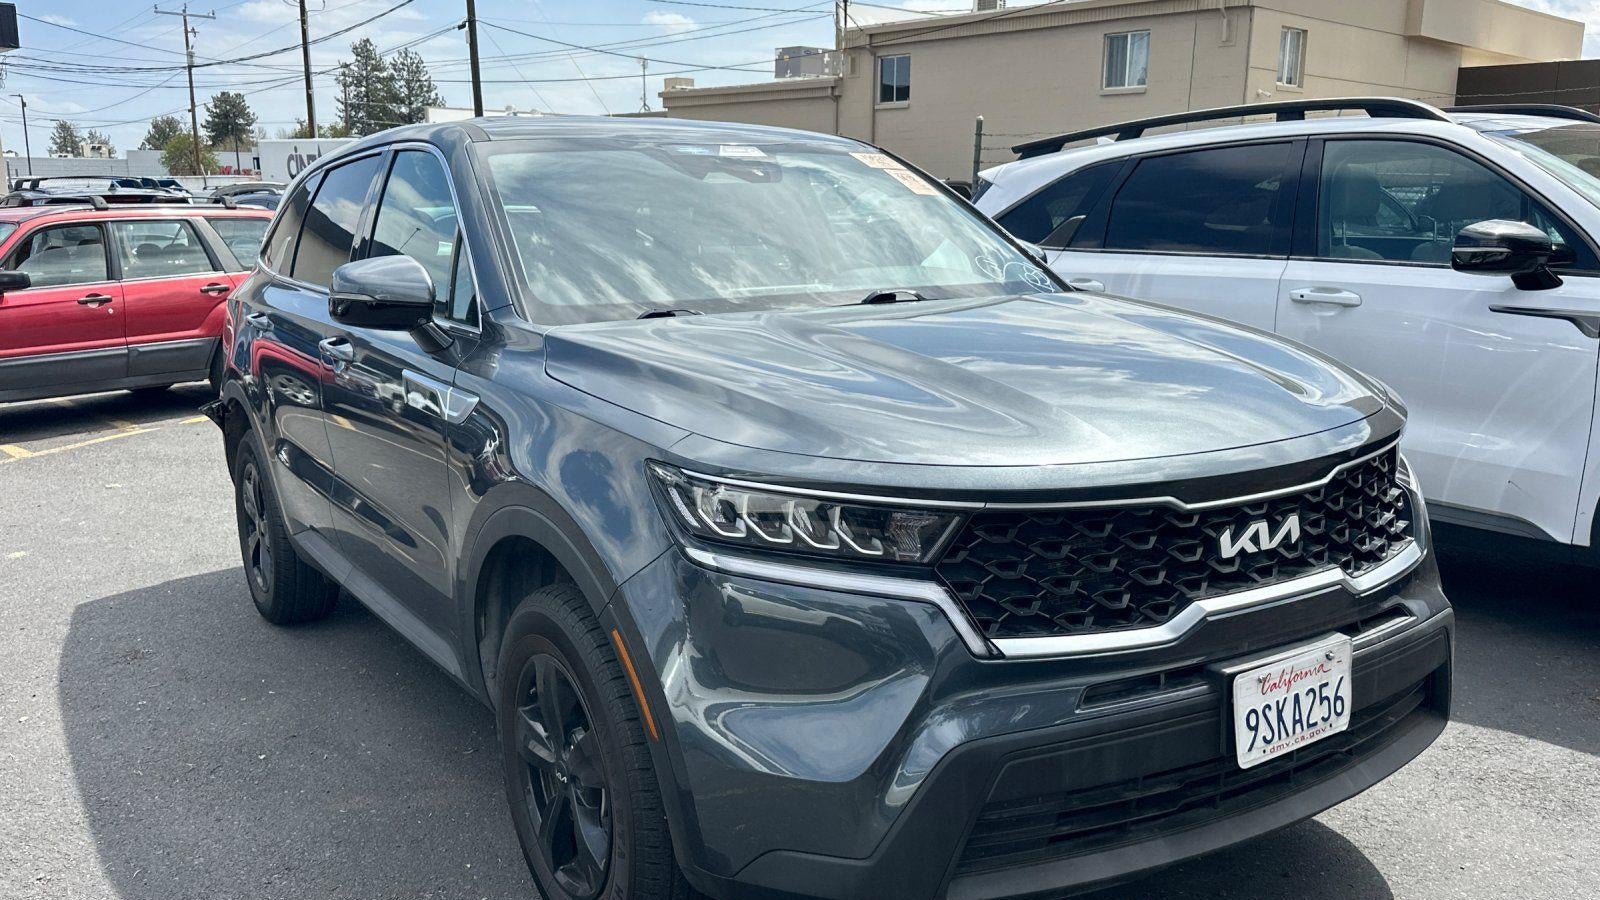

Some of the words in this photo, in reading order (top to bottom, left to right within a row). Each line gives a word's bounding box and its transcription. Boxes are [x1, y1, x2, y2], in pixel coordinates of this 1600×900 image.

[1220, 514, 1300, 559] KIA
[1261, 661, 1332, 695] California
[1245, 675, 1345, 752] 9SKA256
[1269, 726, 1327, 754] dmv.ca.gov
